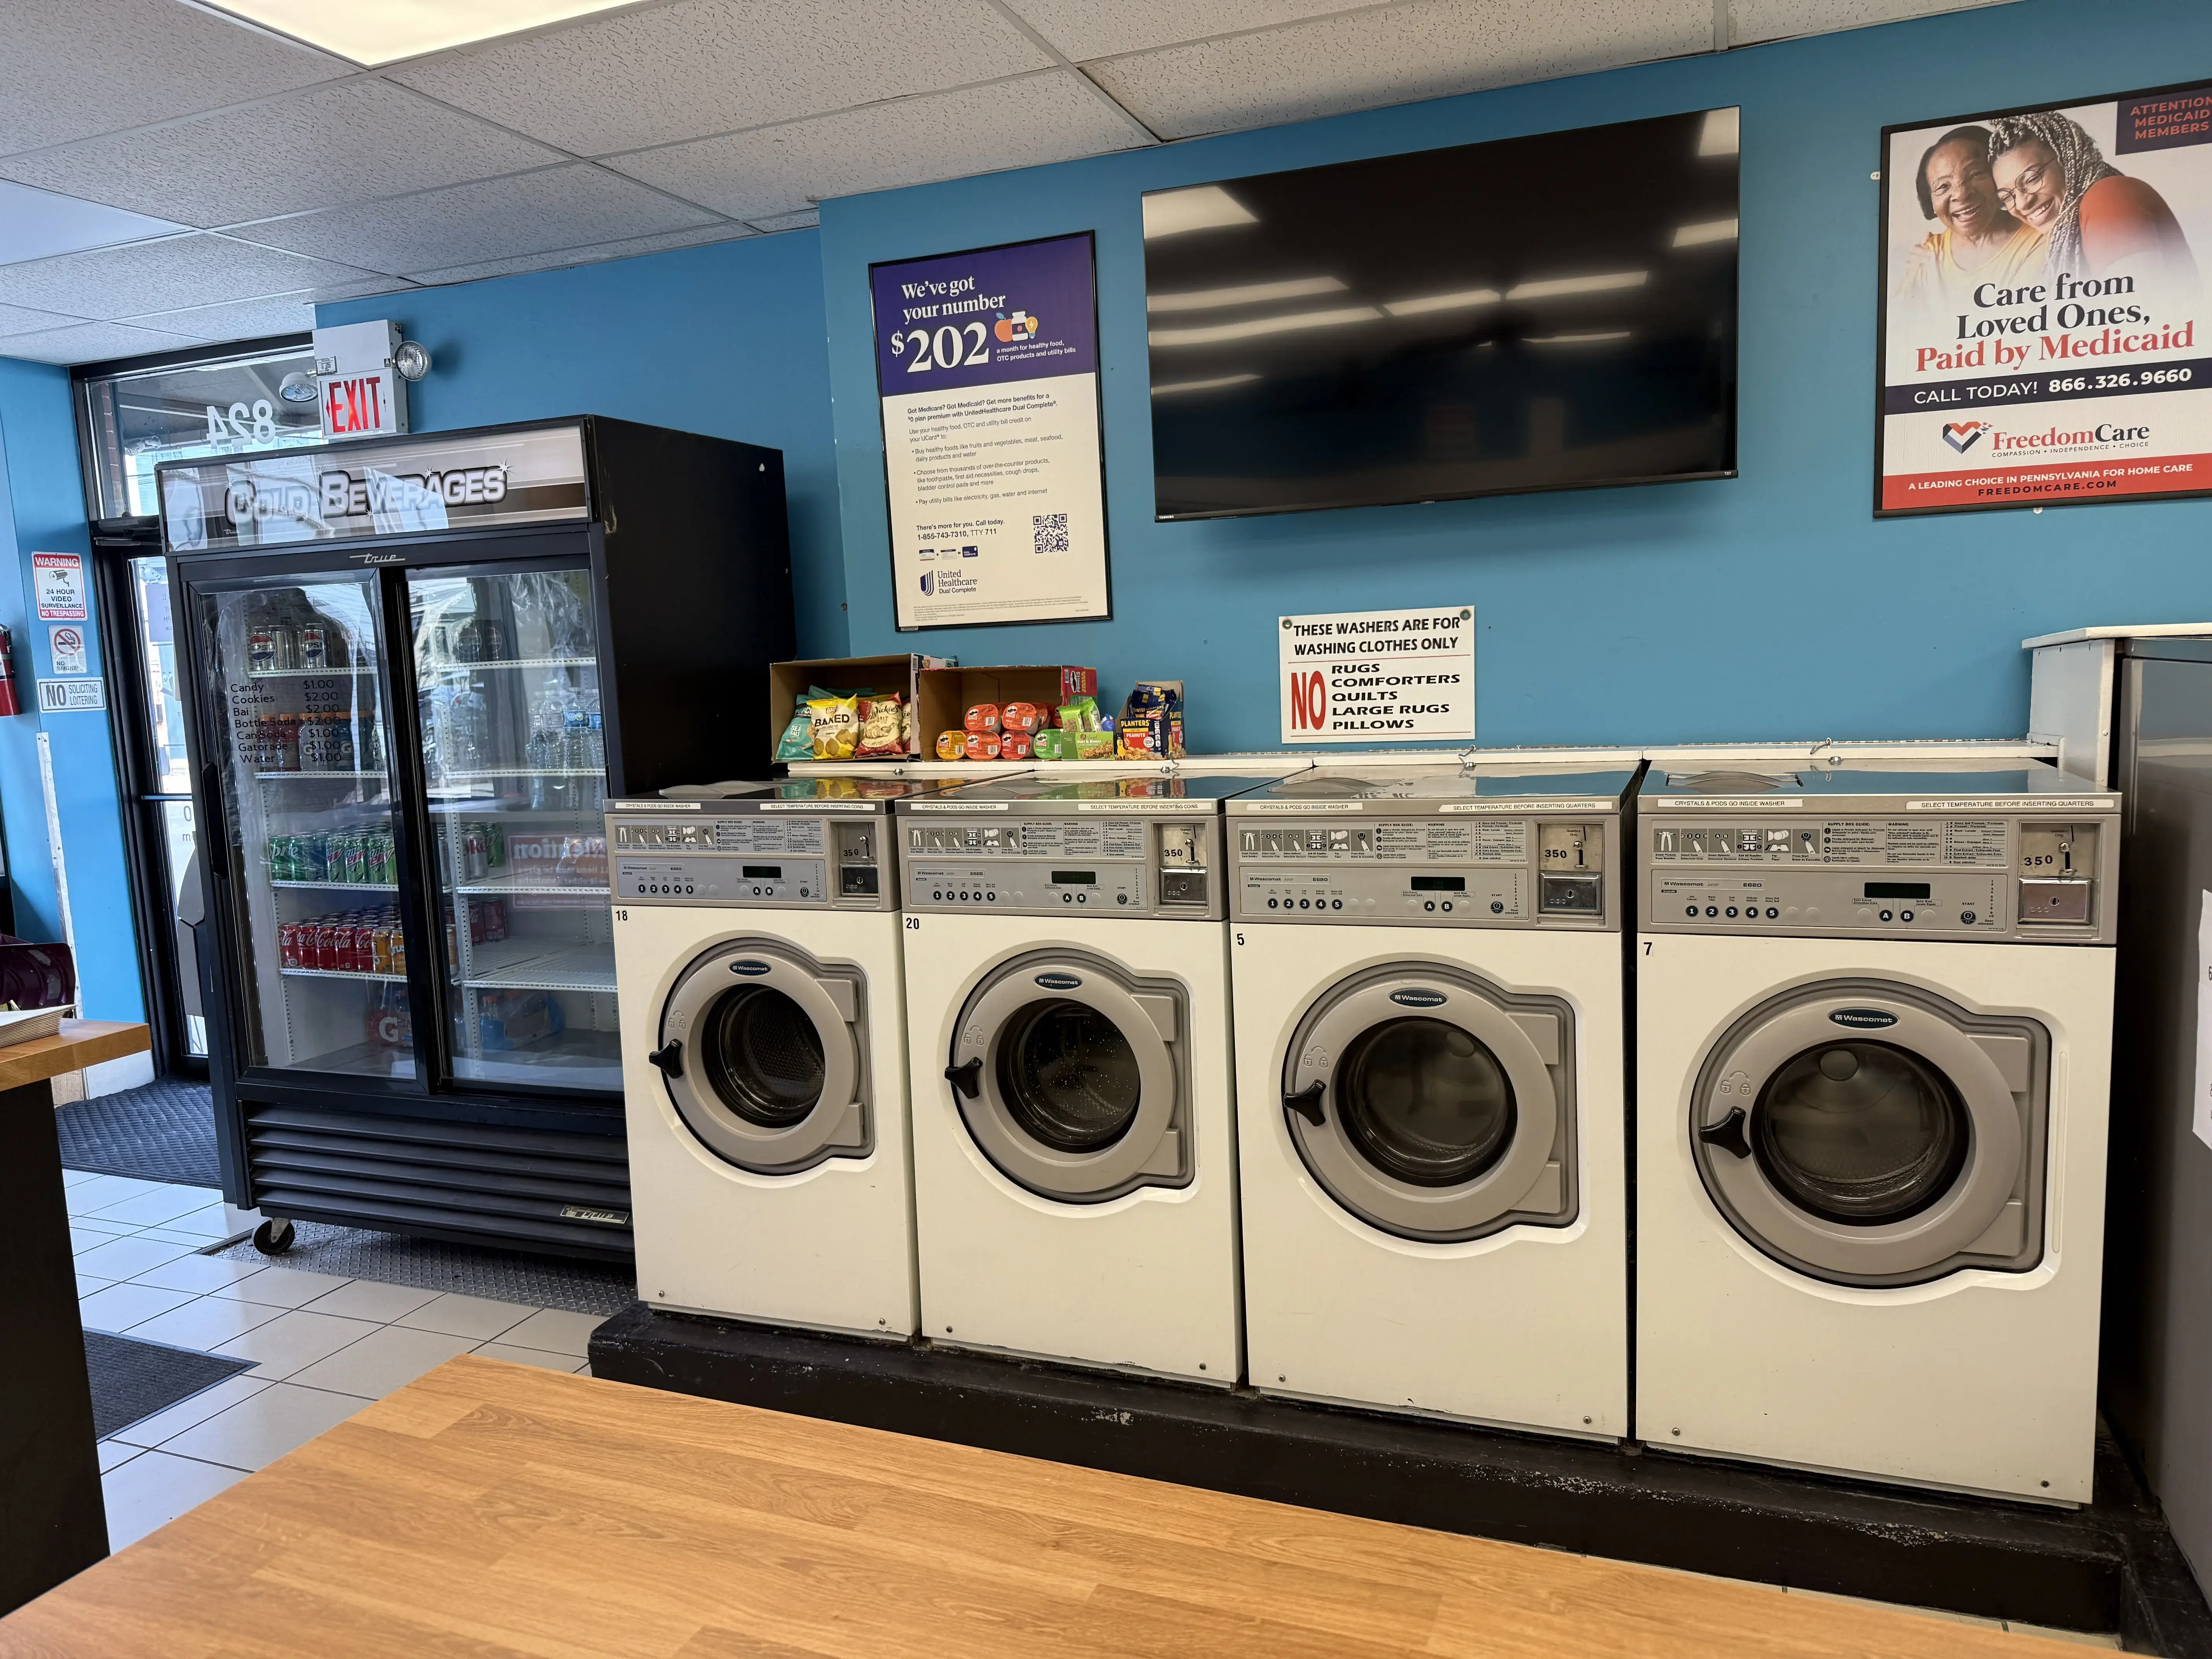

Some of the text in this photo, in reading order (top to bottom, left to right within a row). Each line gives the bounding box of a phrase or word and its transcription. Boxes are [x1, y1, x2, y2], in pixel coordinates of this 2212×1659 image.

[2135, 109, 2211, 128] MEDICAID
[2135, 121, 2209, 140] MEMBERS
[902, 276, 975, 299] We've got
[1973, 273, 2135, 307] Care from
[903, 294, 1006, 325] your number
[1956, 304, 2149, 339] Loved Ones,
[1915, 321, 2195, 373] Paid by Medicaid
[1010, 352, 1034, 361] products
[1914, 368, 2191, 404] CALL TODAY! 866.326.9660
[329, 377, 380, 433] EXIT
[1992, 423, 2150, 450] FreedomCare
[2051, 445, 2109, 453] INDEPENDENCE
[1918, 479, 1962, 489] LEADING
[1965, 477, 2003, 486] CHOICE
[2020, 470, 2100, 482] PENNSYLVANIA
[2128, 466, 2160, 475] HOME
[2163, 464, 2192, 472] CARE
[1978, 480, 2117, 496] FREEDOMCARE.COM
[917, 531, 968, 540] 1-855-743-7310,
[35, 557, 79, 567] WARNING
[938, 570, 962, 579] United
[938, 578, 977, 587] Healthcare
[1293, 617, 1460, 636] THESE WASHERS ARE FOR
[1294, 637, 1458, 655] WASHING CLOTHES ONLY
[1331, 663, 1380, 674] RUGS
[230, 679, 334, 693] Candy $1.00
[1331, 674, 1460, 687] COMFORTERS
[46, 684, 66, 706] NO
[69, 684, 98, 694] SOLICITING
[70, 696, 97, 706] LOITERING
[232, 692, 338, 704] Cookies $2.00
[1291, 670, 1326, 730] NO
[1332, 691, 1398, 701] QUILTS
[233, 704, 339, 716] Bai $2.00
[1332, 704, 1449, 716] LARGE RUGS
[235, 716, 341, 728] Bottle Soda $2.00
[814, 714, 850, 727] BAKED
[1333, 719, 1414, 730] PILLOWS
[237, 729, 340, 740] Can Soda $1.00
[238, 740, 340, 752] Gatorade $1.00
[240, 753, 342, 763] Water $1.00
[1544, 849, 1567, 859] 350
[2024, 855, 2053, 866] 350
[616, 910, 628, 921] 18
[906, 917, 920, 929] 20
[1237, 933, 1244, 945] 5
[1644, 942, 1652, 955] 7
